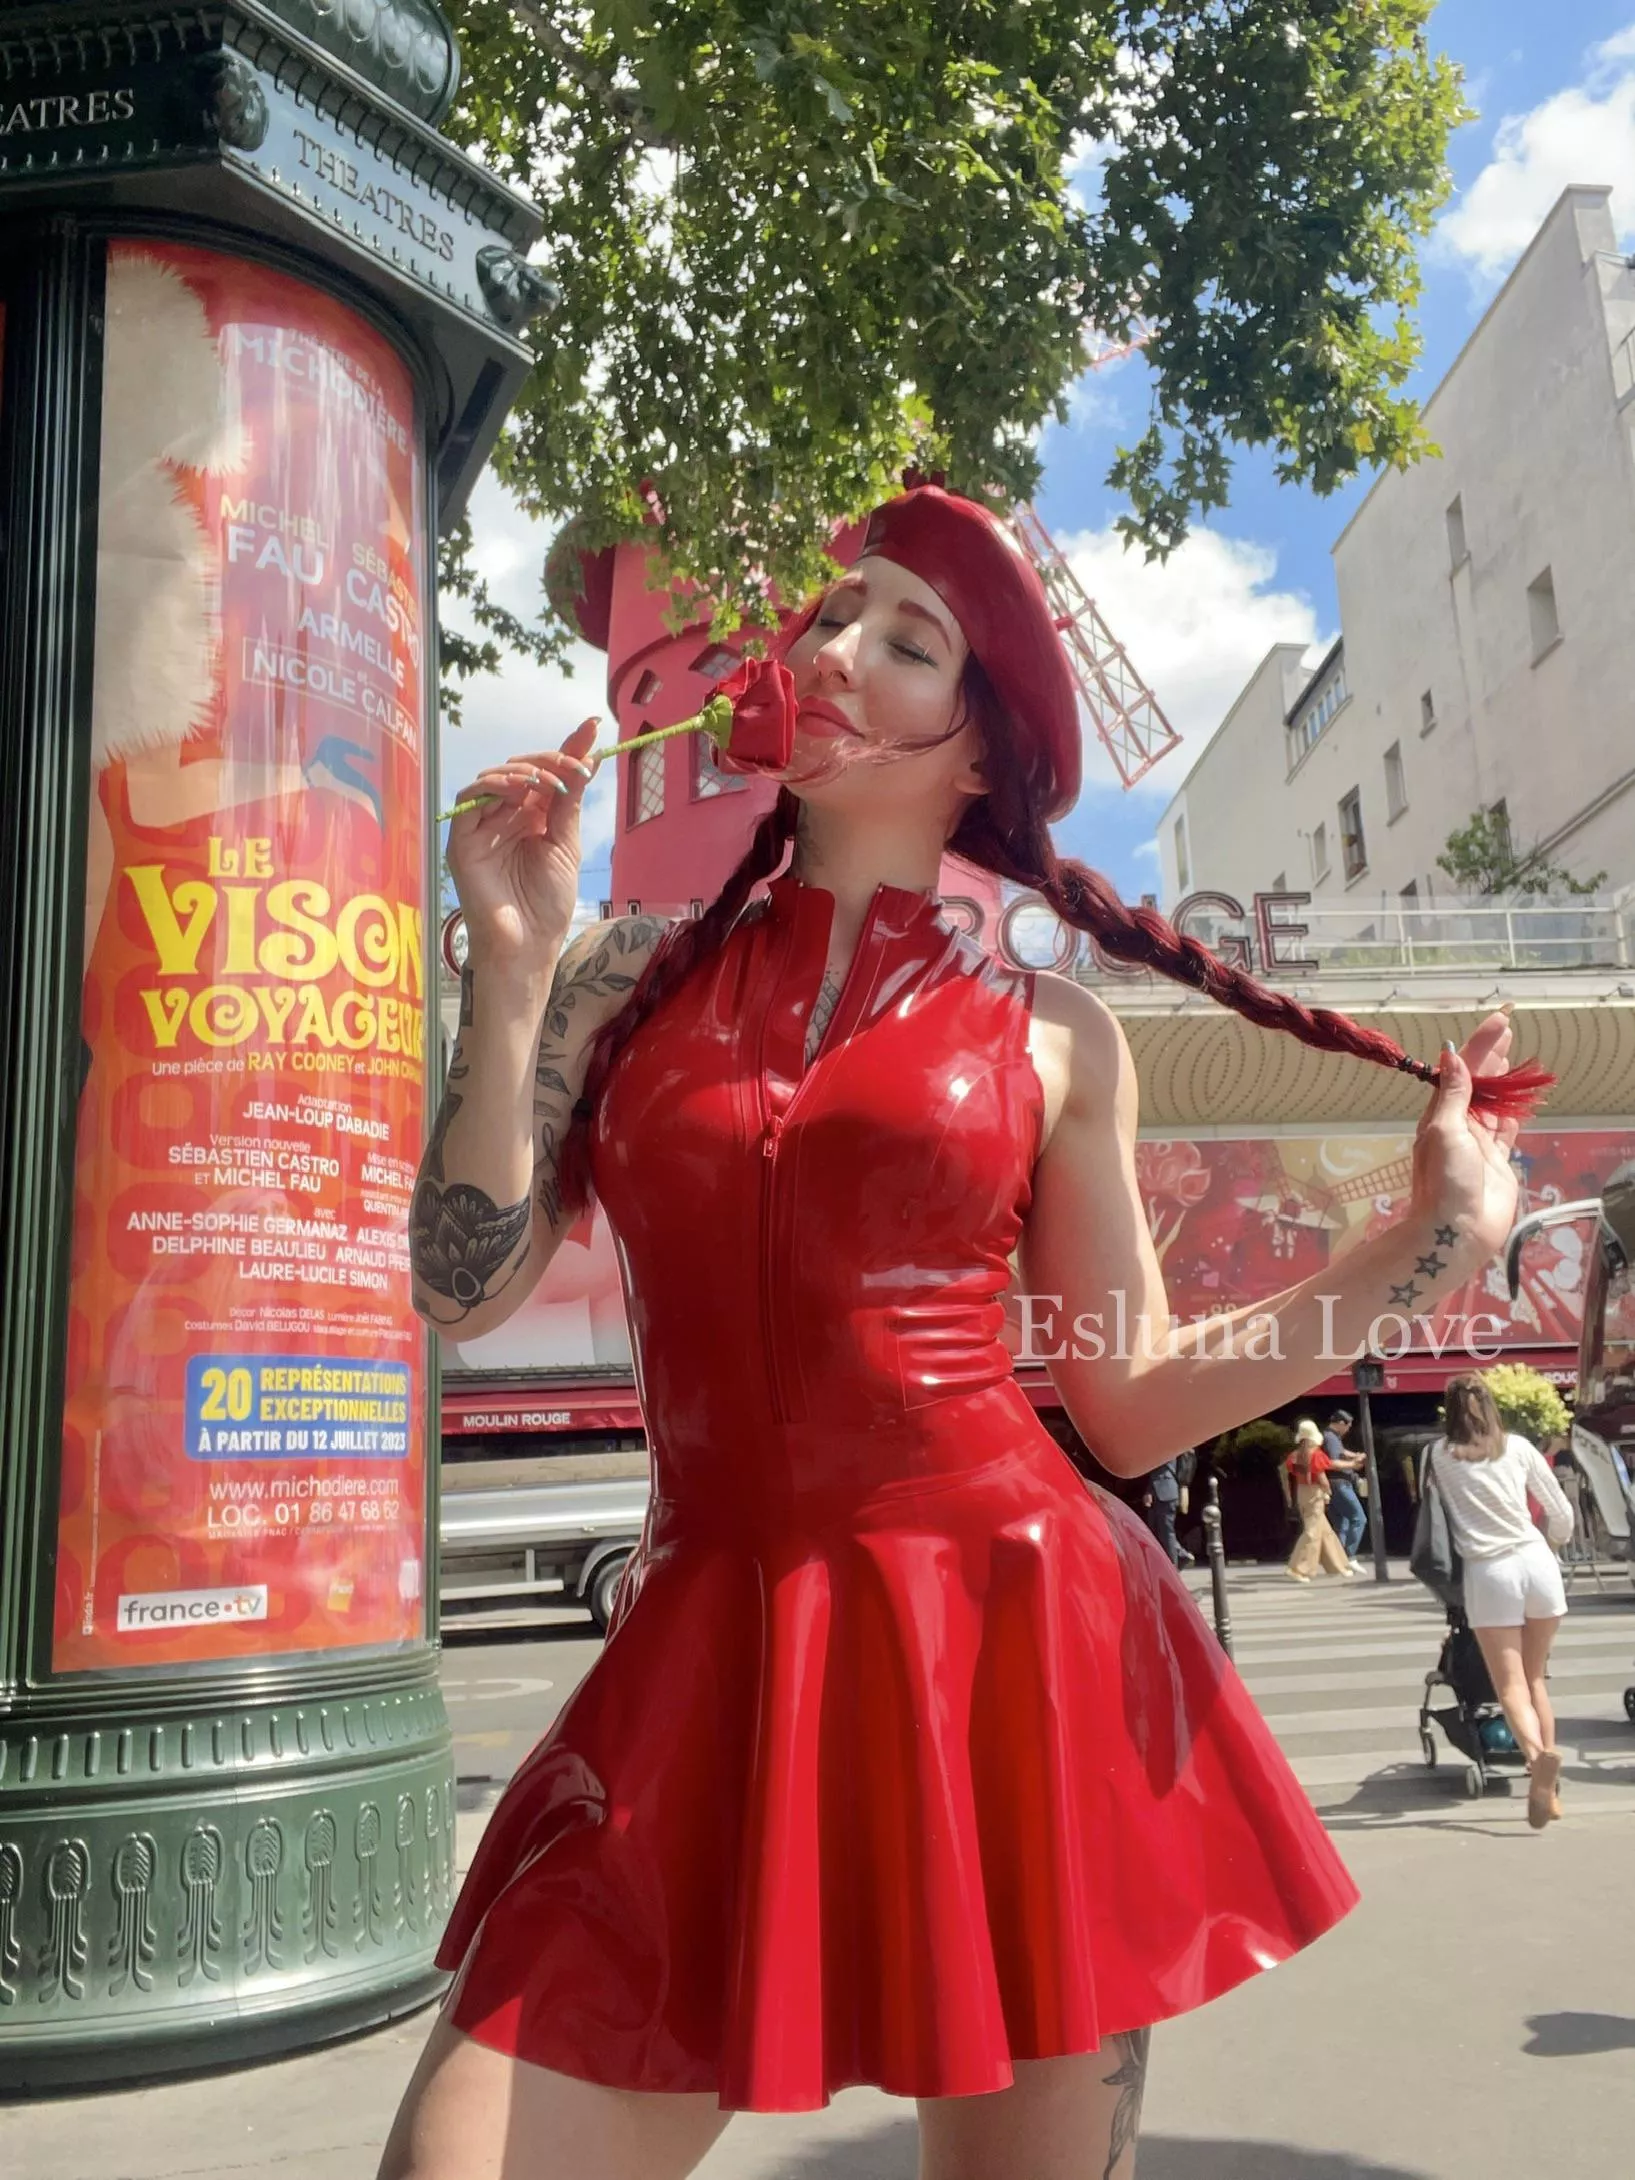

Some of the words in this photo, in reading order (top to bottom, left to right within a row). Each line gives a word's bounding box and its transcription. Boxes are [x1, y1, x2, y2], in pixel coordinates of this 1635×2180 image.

[293, 128, 455, 262] THEATRES
[221, 493, 329, 550] MICHEL
[228, 524, 324, 585] FAU
[298, 606, 404, 688] ARMELLE
[252, 647, 357, 704] NICOLE
[361, 687, 417, 752] CALFAN
[207, 835, 275, 880] LE
[123, 864, 422, 999] VISON
[940, 890, 1320, 978] OGE
[152, 1061, 181, 1076] Une
[184, 1057, 223, 1077] pièce
[226, 1058, 245, 1071] de
[247, 1051, 287, 1071] RAY
[291, 1051, 353, 1073] COONEY
[354, 1061, 366, 1075] et
[367, 1056, 400, 1078] JOHN
[243, 1101, 333, 1128] JEAN-LOUP
[336, 1115, 390, 1141] DABADIE
[209, 1133, 261, 1148] Version
[263, 1137, 311, 1154] nouvelle
[168, 1142, 273, 1168] SÉBASTIEN
[278, 1152, 340, 1177] CASTRO
[194, 1172, 211, 1185] ET
[214, 1167, 286, 1189] MICHEL
[290, 1174, 321, 1193] FAU
[361, 1164, 403, 1188] MICHEL
[127, 1211, 259, 1234] ANNE-SOPHIE
[263, 1215, 347, 1241] GERMANAZ
[313, 1209, 336, 1221] avec
[153, 1236, 246, 1256] DELPHINE
[251, 1239, 326, 1261] BEAULIEU
[356, 1227, 397, 1248] ALEXIS
[335, 1248, 386, 1268] ARNAUD
[239, 1261, 346, 1284] LAURE-LUCILE
[349, 1271, 388, 1290] SIMON
[184, 1320, 233, 1331] Costumes
[235, 1319, 265, 1331] David
[260, 1363, 406, 1395] REPRÉSENTATIONS
[200, 1367, 252, 1421] 20
[260, 1396, 406, 1424] EXCEPTIONNELLES
[463, 1413, 518, 1428] MOULIN
[521, 1411, 571, 1426] ROUGE
[198, 1427, 212, 1452] À
[217, 1430, 281, 1451] PARTIR
[286, 1430, 309, 1451] DU
[312, 1430, 327, 1450] 12
[330, 1430, 379, 1451] JUILLET
[381, 1431, 406, 1451] 2023
[209, 1476, 399, 1500] www.michodiere.com
[207, 1503, 267, 1528] LOC.
[274, 1502, 300, 1525] 01
[309, 1501, 333, 1523] 86
[338, 1500, 355, 1521] 47
[360, 1501, 380, 1521] 68
[383, 1500, 400, 1520] 62
[263, 1526, 287, 1537] FNAC
